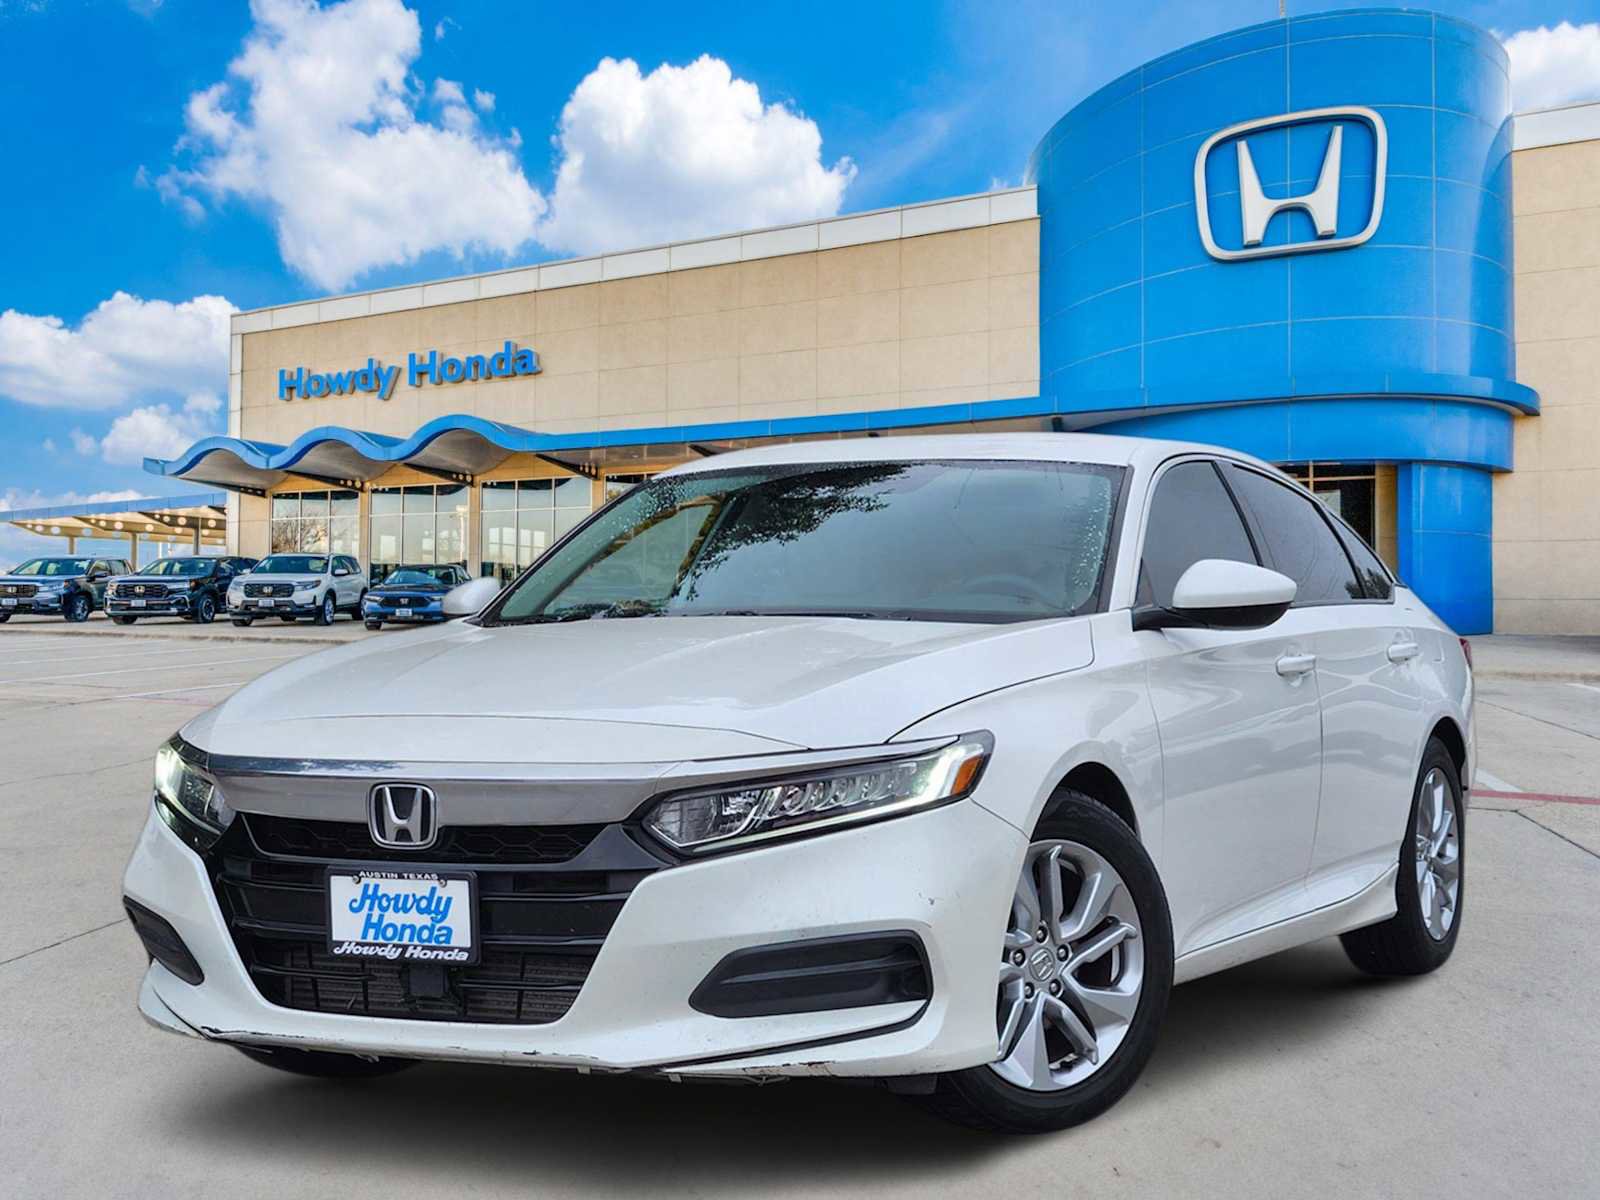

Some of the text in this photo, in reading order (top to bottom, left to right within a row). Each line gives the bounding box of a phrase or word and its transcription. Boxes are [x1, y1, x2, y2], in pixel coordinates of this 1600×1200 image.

[278, 340, 541, 401] Howdy Honda
[358, 870, 398, 880] AUSTIN
[348, 883, 453, 924] Howdy
[361, 913, 453, 945] Honda
[333, 942, 469, 961] Howdy Honda
